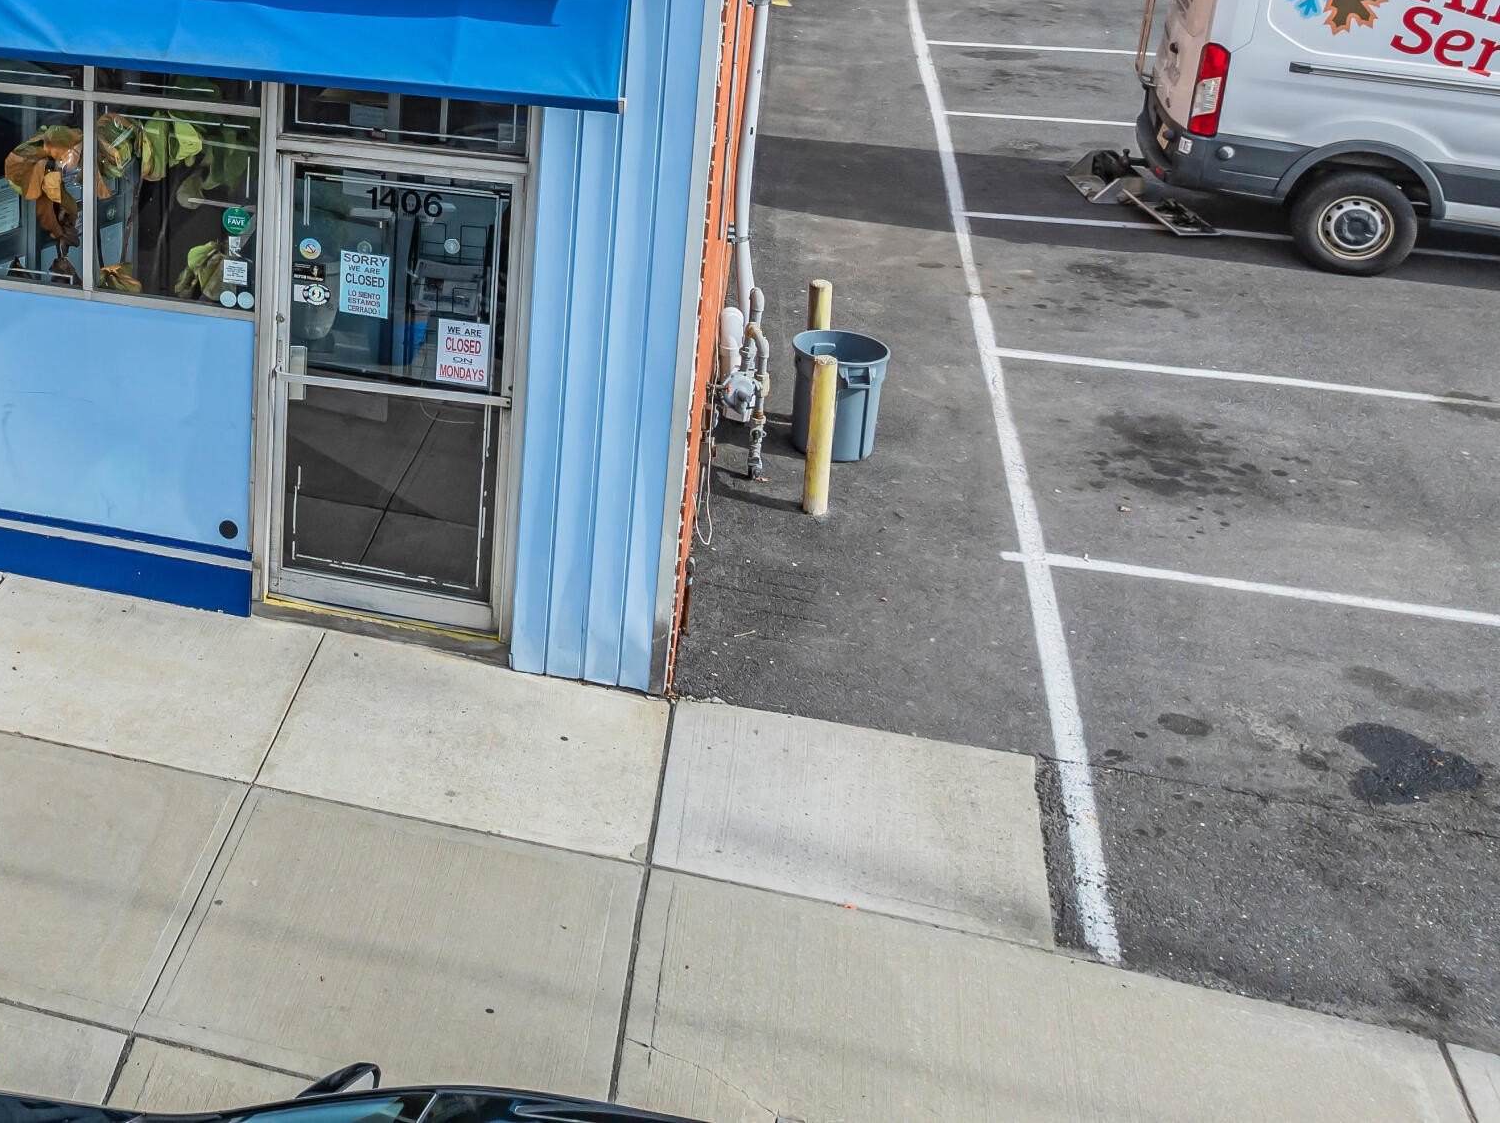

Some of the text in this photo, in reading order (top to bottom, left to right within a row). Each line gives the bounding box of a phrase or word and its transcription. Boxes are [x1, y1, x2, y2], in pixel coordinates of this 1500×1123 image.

[366, 186, 443, 218] 1406
[227, 218, 246, 227] FAVE
[343, 253, 388, 267] SORRY
[348, 265, 381, 275] WE ARE
[345, 273, 385, 288] CLOSED
[358, 291, 381, 300] SIENTO
[347, 297, 381, 308] ESTAMOS
[447, 326, 482, 337] WE ARE
[445, 337, 482, 354] CLOSED
[439, 363, 484, 382] MONDAYS
